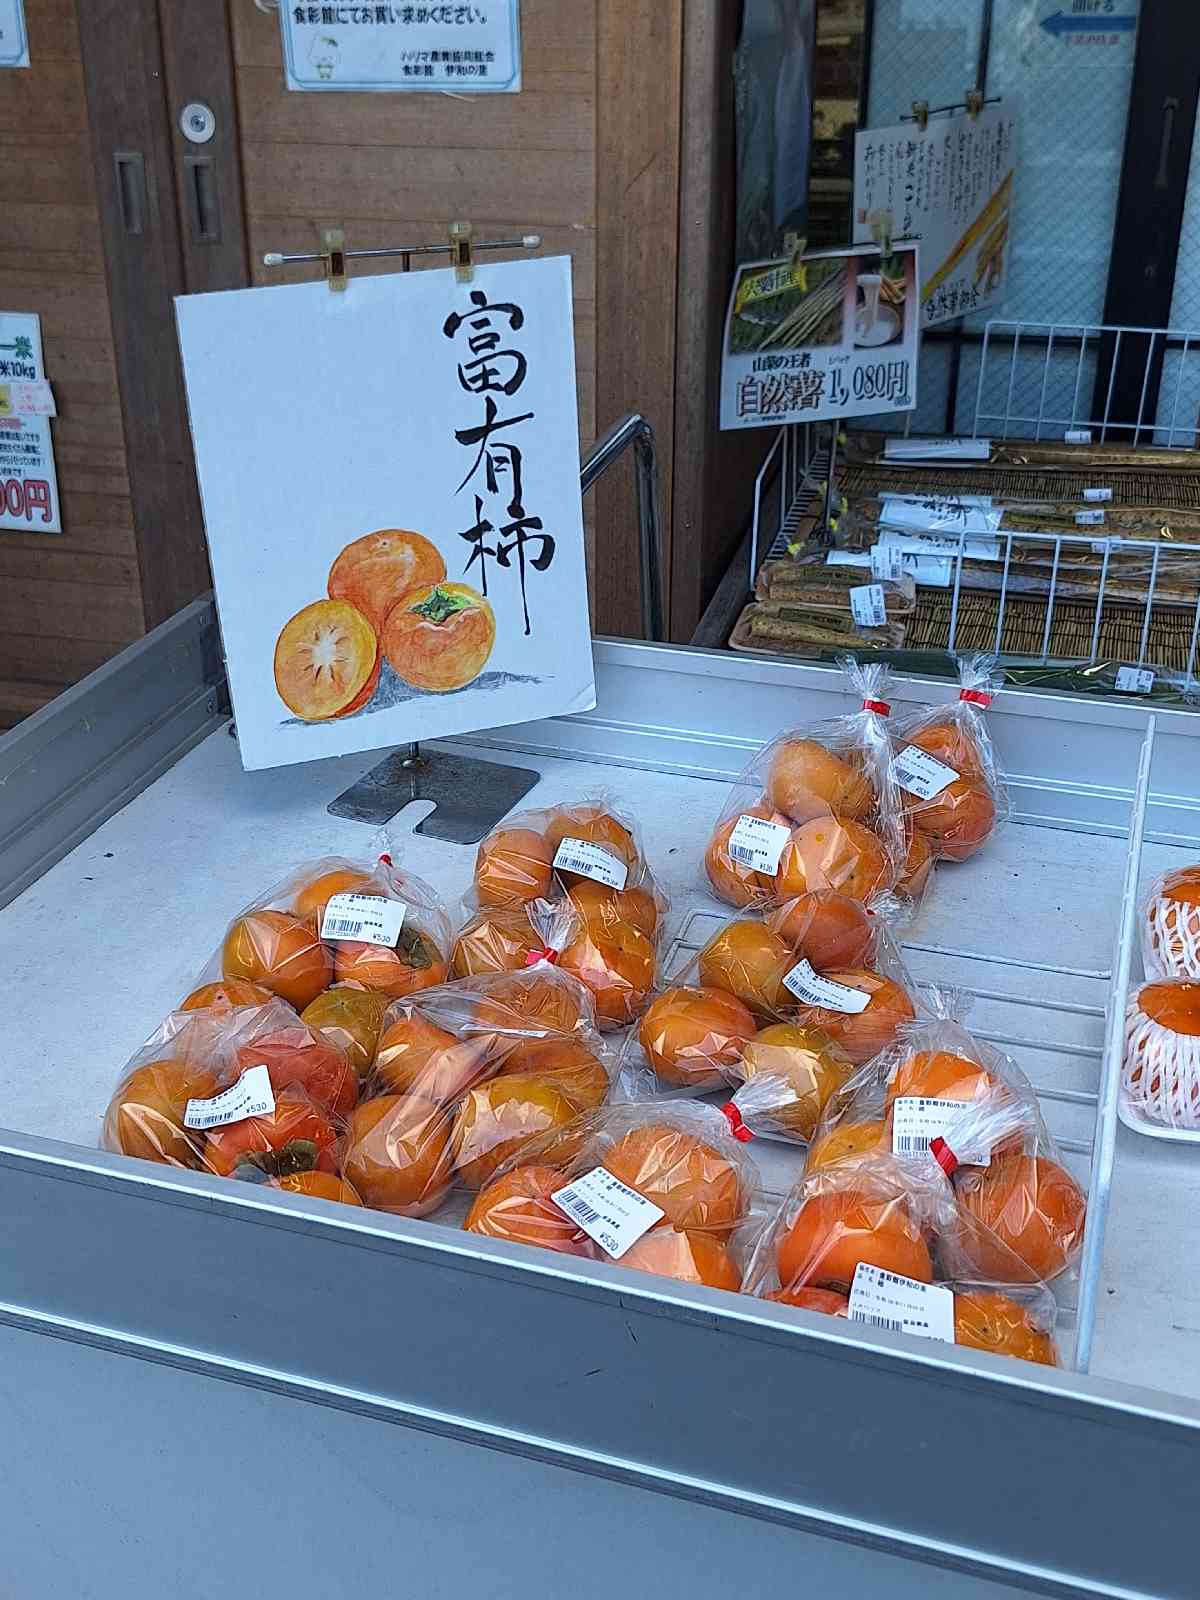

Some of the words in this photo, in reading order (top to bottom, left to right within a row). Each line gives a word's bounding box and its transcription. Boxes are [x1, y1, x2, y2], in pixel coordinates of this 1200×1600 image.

[292, 6, 488, 25] 食彩館にてお買い求めください。
[737, 369, 827, 418] 自然薯
[829, 361, 909, 405] 1,080円
[443, 290, 555, 635] 富有柿
[246, 1102, 267, 1114] ¥530
[600, 1232, 619, 1251] ¥530
